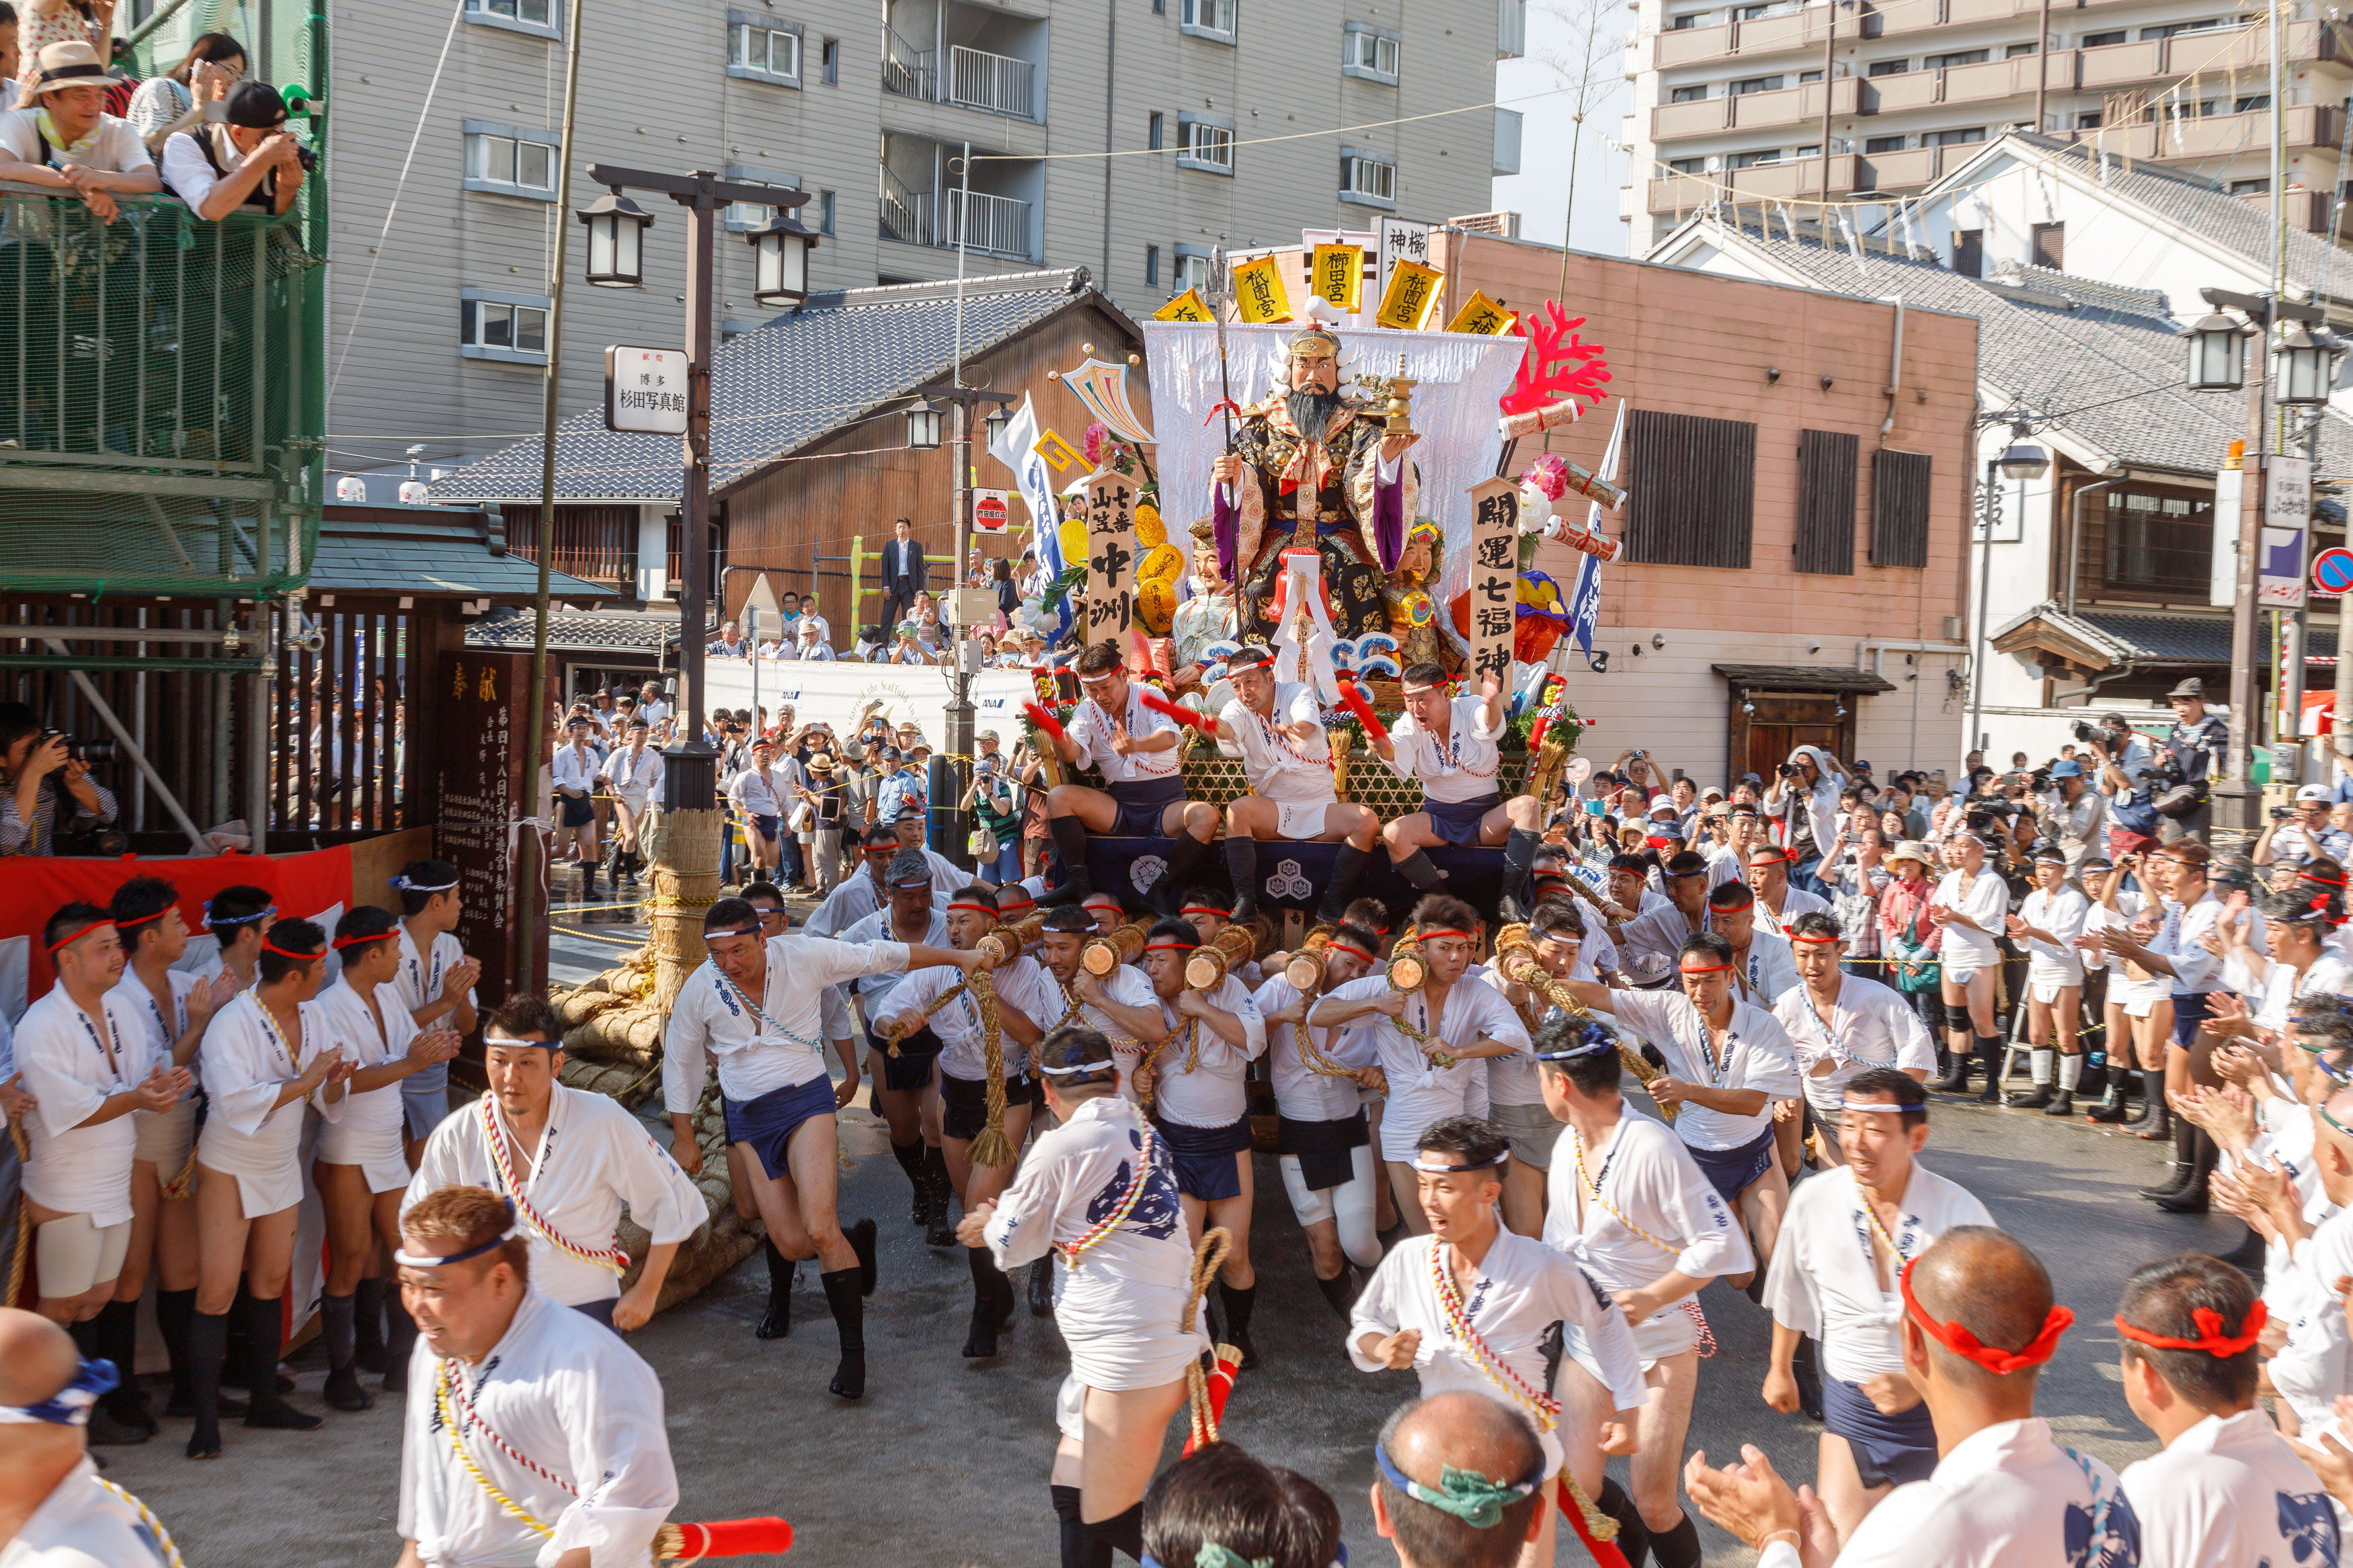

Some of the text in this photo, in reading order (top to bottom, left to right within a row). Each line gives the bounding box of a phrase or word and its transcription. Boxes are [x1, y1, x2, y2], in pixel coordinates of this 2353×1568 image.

[1408, 229, 1426, 258] 櫛
[1244, 268, 1275, 319] 祇園宮
[1326, 251, 1350, 303] 櫛田宮
[1396, 272, 1426, 323] 祇園宮
[640, 372, 665, 386] 博多
[619, 388, 685, 413] 杉田写真館
[1090, 486, 1113, 536] 山笠
[1112, 485, 1134, 533] 七番
[1474, 491, 1518, 693] 開運七福神
[781, 691, 793, 700] ANA
[867, 683, 878, 695] the
[881, 679, 910, 704] Scaffold
[982, 699, 996, 708] ANA
